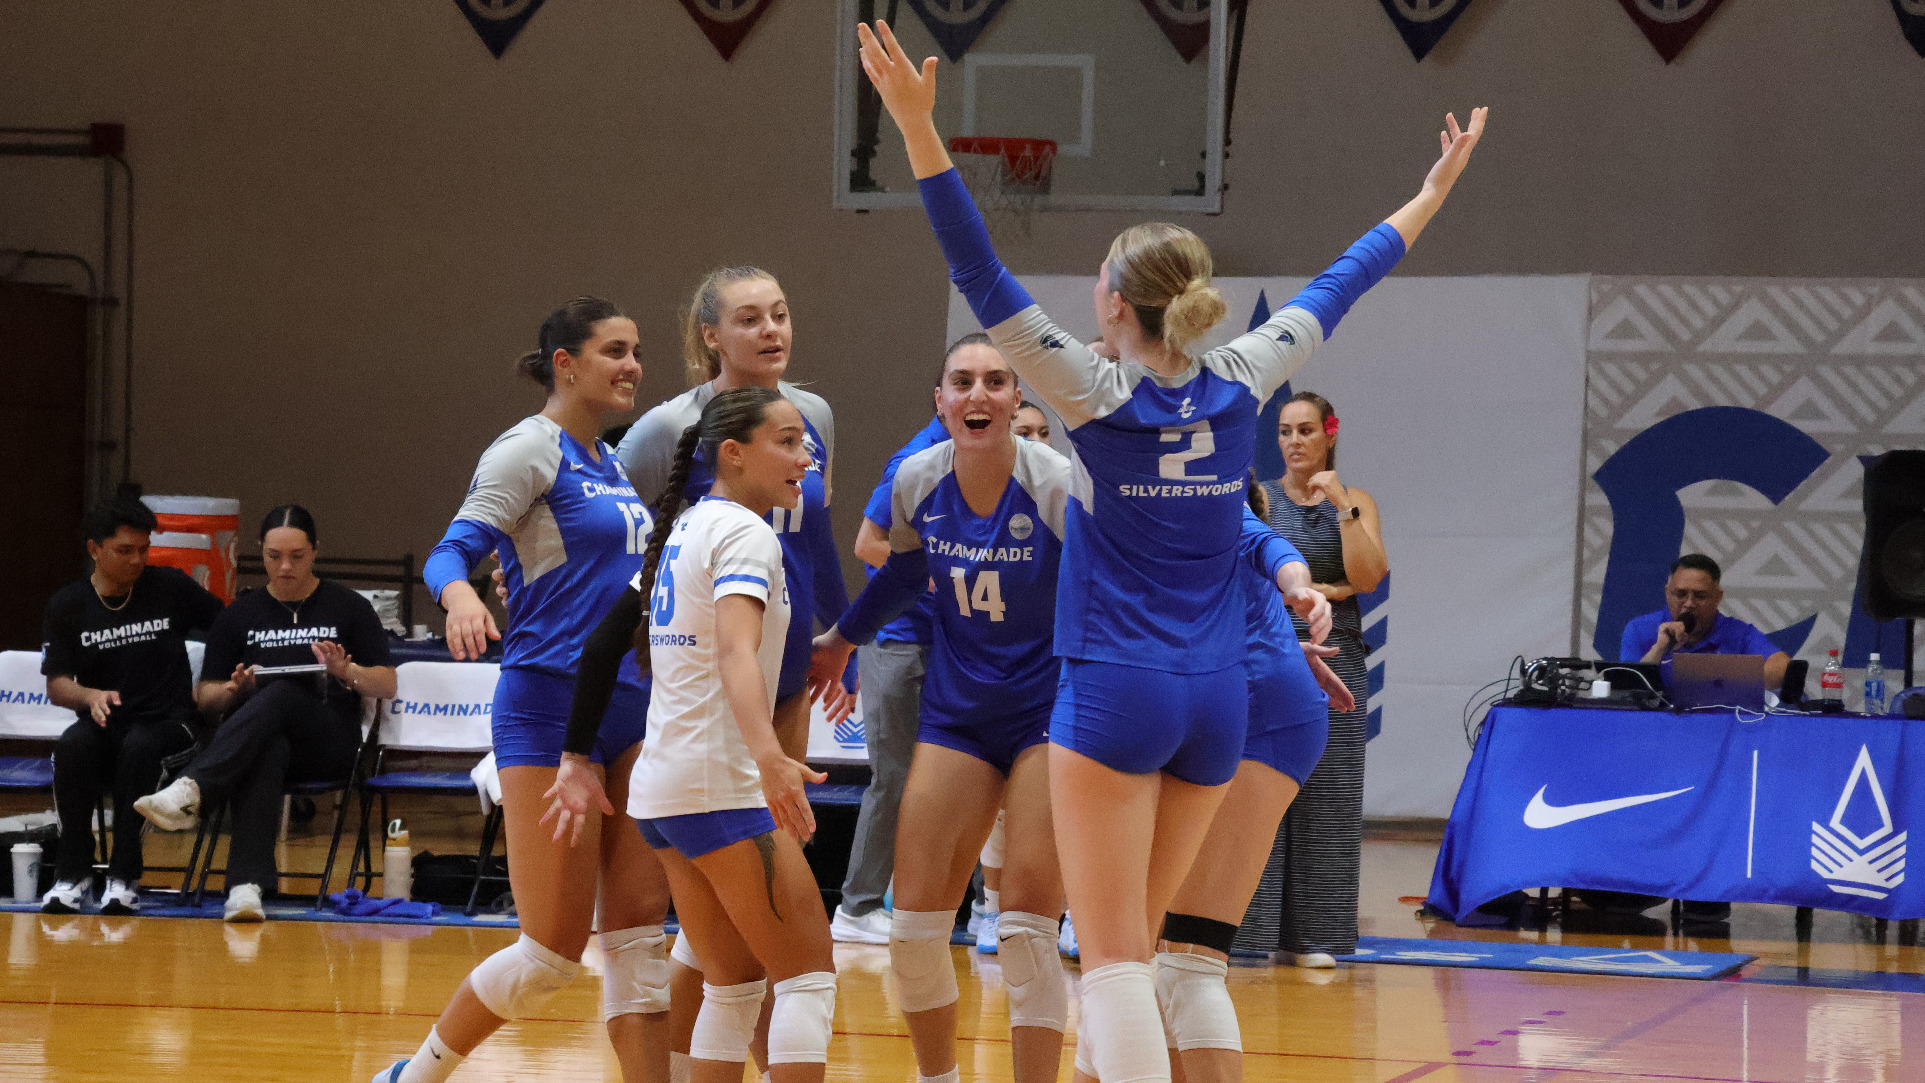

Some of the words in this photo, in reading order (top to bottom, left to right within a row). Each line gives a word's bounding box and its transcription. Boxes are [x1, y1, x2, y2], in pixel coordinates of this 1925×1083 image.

[1159, 420, 1218, 481] 2
[1119, 478, 1243, 497] SILVERSWORDS
[616, 502, 654, 555] 12
[927, 536, 1033, 562] CHAMINADE
[650, 545, 682, 627] 15
[950, 566, 1006, 622] 14
[81, 618, 170, 647] CHAMINADE
[99, 633, 157, 650] VOLLEYBALL
[246, 627, 338, 645] CHAMINADE
[0, 690, 54, 705] HAMI
[390, 699, 493, 716] CHAMINAD
